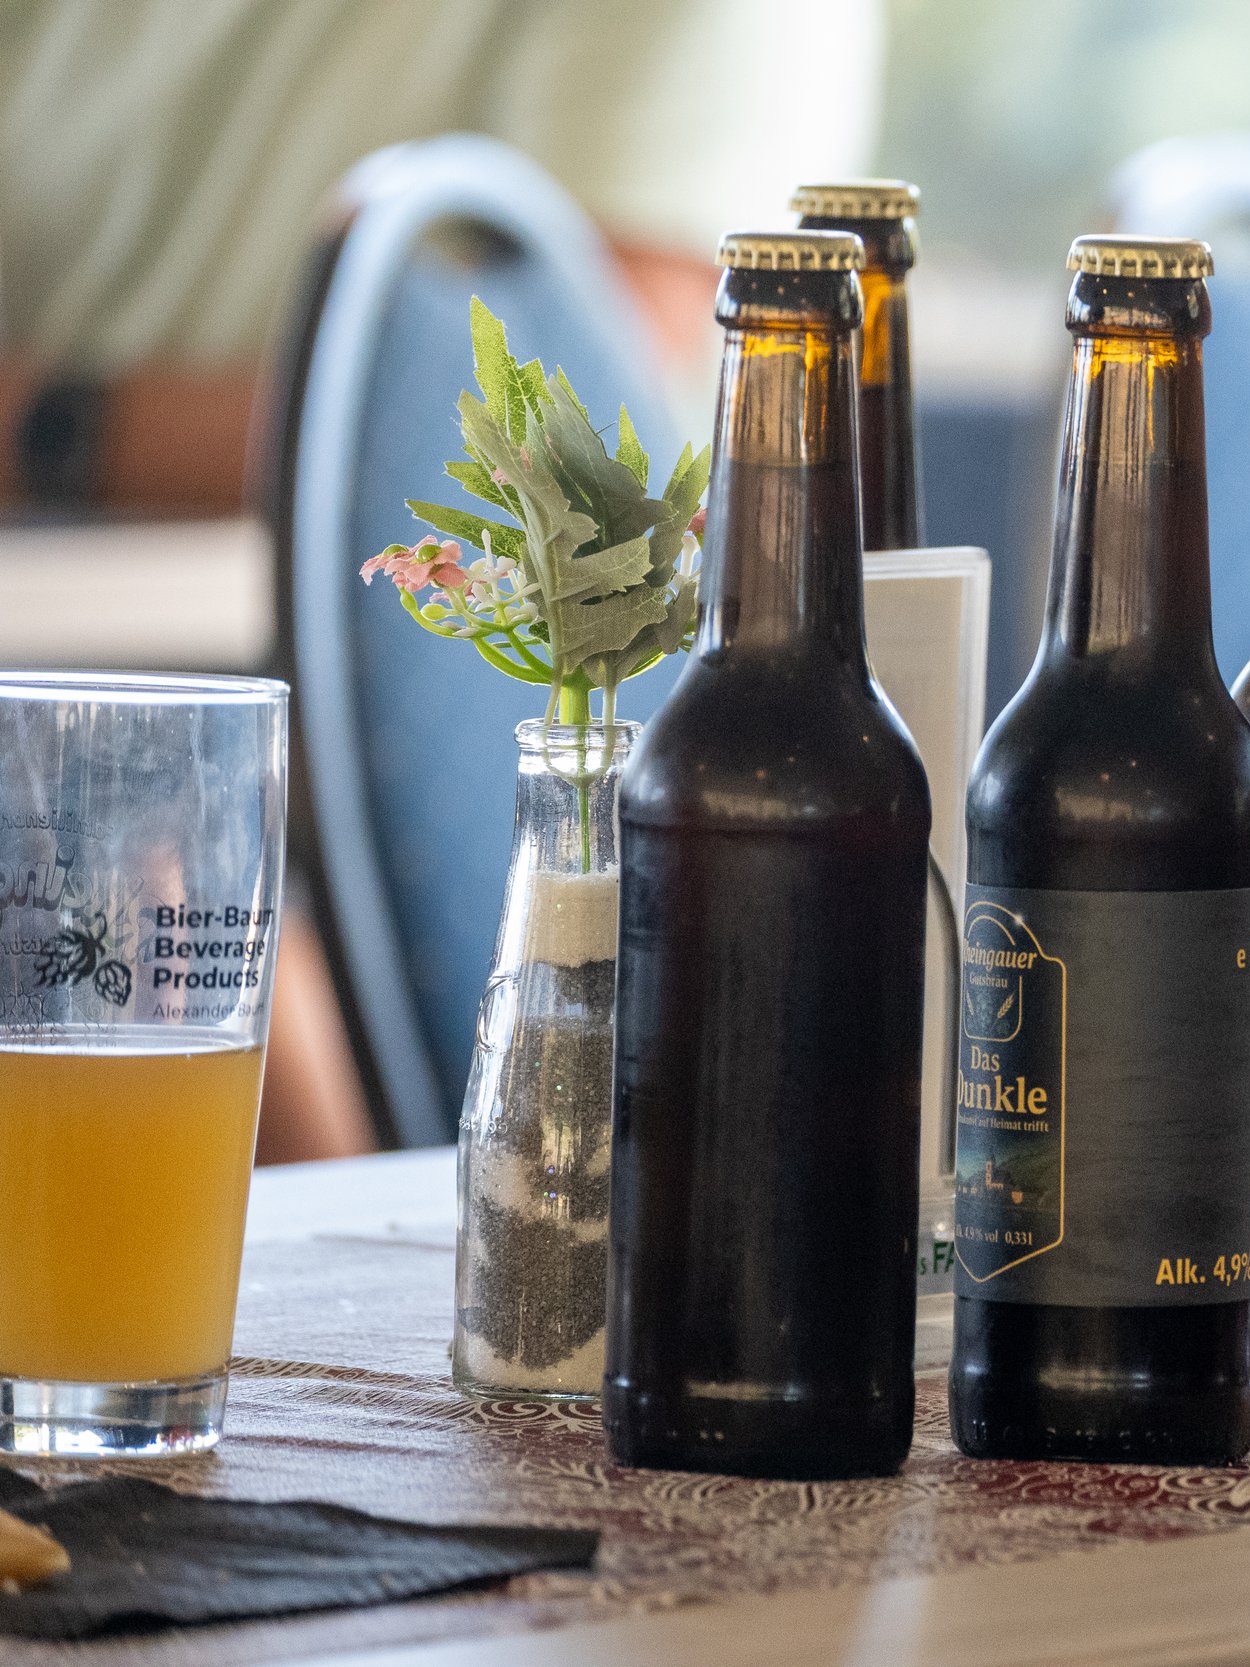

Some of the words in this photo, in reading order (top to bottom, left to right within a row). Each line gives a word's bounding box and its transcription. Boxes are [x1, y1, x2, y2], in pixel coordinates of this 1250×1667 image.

[154, 937, 266, 963] Beverage
[153, 966, 259, 989] Products
[970, 1045, 1001, 1073] Das
[1023, 1119, 1050, 1133] trifft
[1155, 1257, 1206, 1285] Alk.
